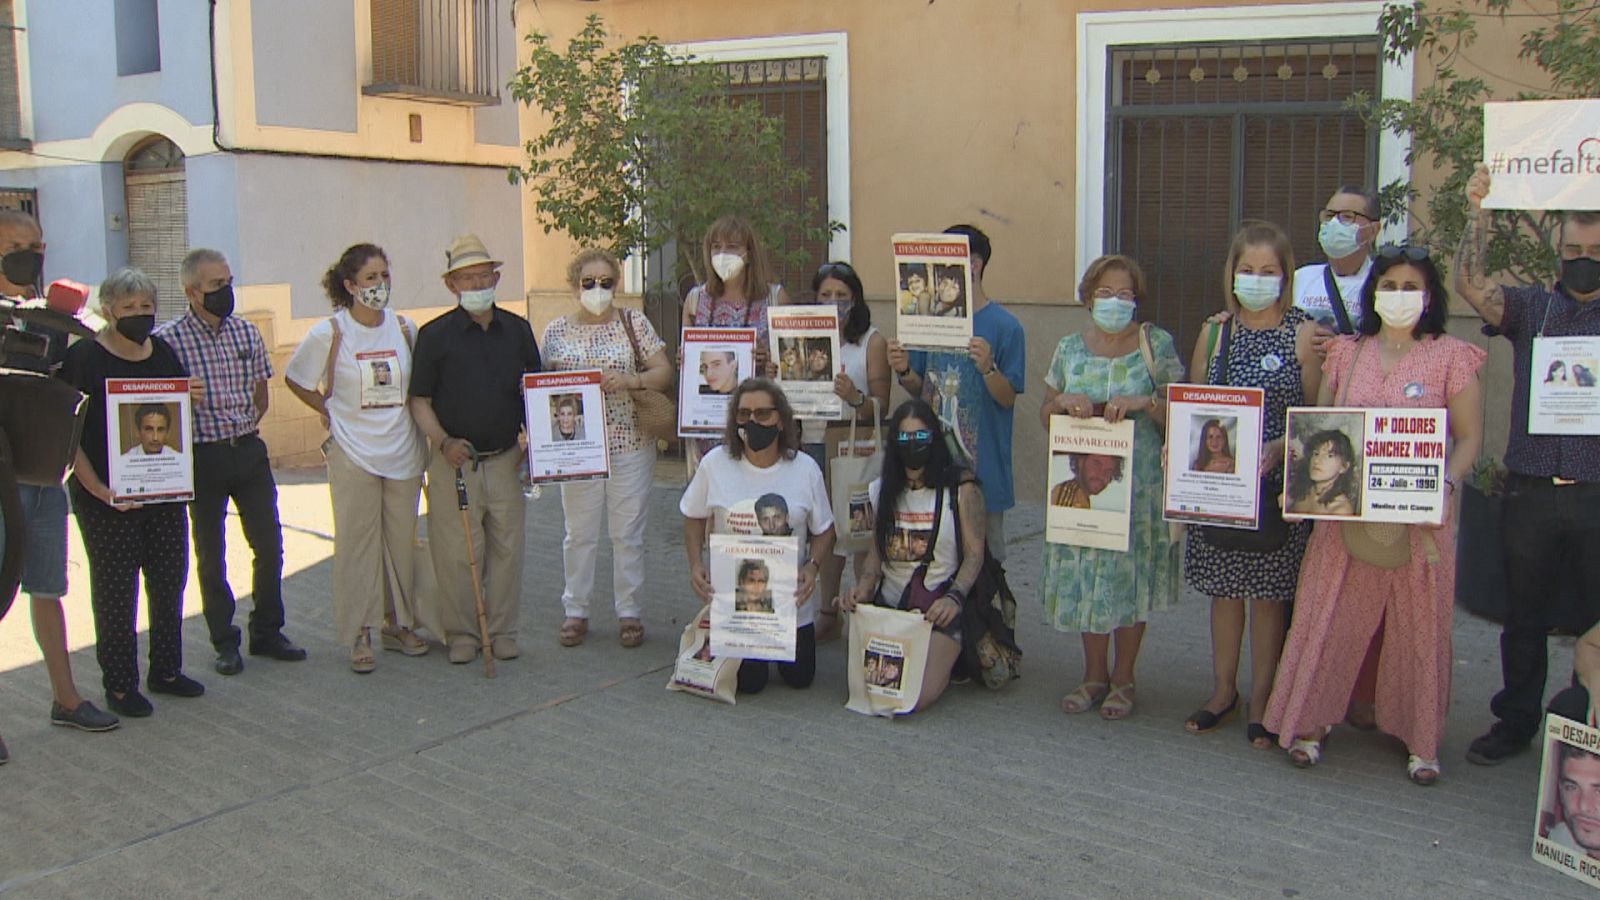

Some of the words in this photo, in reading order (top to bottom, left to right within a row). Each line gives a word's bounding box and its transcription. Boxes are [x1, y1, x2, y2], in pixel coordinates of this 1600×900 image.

[898, 245, 965, 254] DESAPARECIDOS
[536, 376, 590, 386] DESAPARECIDA
[122, 383, 176, 391] DESAPARECIDO
[1183, 392, 1247, 403] DESAPARECIDA
[1391, 417, 1436, 434] DOLORES
[1054, 435, 1128, 449] DESAPARECIDO
[1366, 438, 1411, 457] SÁNCHEZ
[1413, 442, 1443, 459] MOYA
[1372, 465, 1425, 475] DESAPARECIDA
[1371, 477, 1382, 487] 24
[1390, 478, 1408, 488] Julio
[1415, 479, 1436, 489] 1990
[725, 546, 784, 556] DESAPARECIDO
[1535, 841, 1578, 871] MANUEL
